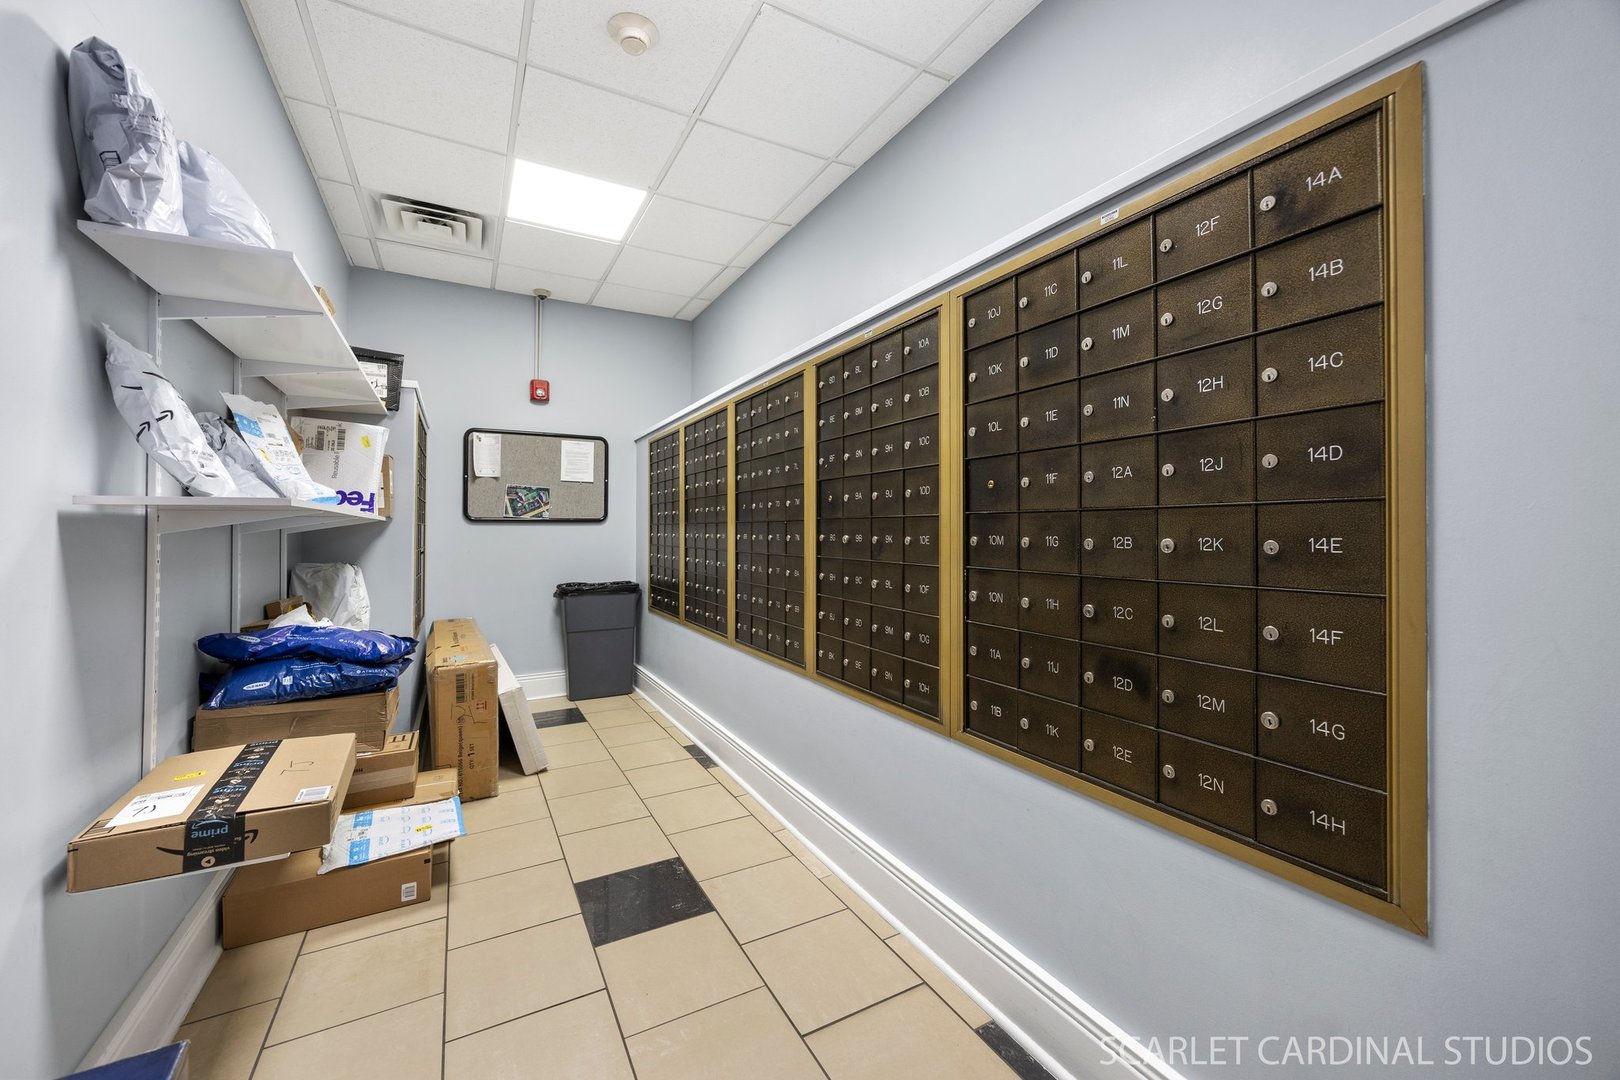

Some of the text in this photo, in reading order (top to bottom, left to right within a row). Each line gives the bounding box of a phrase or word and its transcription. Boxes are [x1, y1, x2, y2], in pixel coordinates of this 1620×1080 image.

[1306, 167, 1342, 191] 14A
[1196, 216, 1220, 236] 12F
[1113, 257, 1128, 270] 11L
[1309, 259, 1343, 281] 14B
[1044, 283, 1057, 296] 11C
[1197, 296, 1222, 314] 12G
[988, 306, 1000, 319] 10J
[1112, 324, 1129, 340] 11M
[919, 338, 929, 348] 10A
[1046, 347, 1058, 359] 11D
[1308, 352, 1343, 372] 14C
[988, 363, 1002, 375] 10K
[1198, 376, 1223, 392] 12H
[919, 387, 929, 396] 10B
[1113, 396, 1129, 408] 11N
[1046, 410, 1058, 421] 11E
[988, 422, 1002, 432] 10L
[919, 436, 929, 445] 10C
[1308, 445, 1342, 462] 14D
[1200, 457, 1222, 471] 12J
[1046, 473, 1058, 484] 11F
[1112, 466, 1132, 478] 12A
[920, 486, 930, 494] 10D
[920, 536, 930, 544] 10E
[989, 535, 1004, 545] 10M
[1046, 536, 1058, 546] 11G
[1112, 537, 1132, 548] 12B
[1198, 538, 1223, 551] 12K
[1309, 538, 1342, 553] 14E
[920, 585, 929, 593] 10F
[989, 592, 1003, 603] 10N
[1046, 598, 1059, 610] 11H
[1113, 606, 1133, 620] 12C
[1199, 616, 1223, 632] 12L
[919, 634, 929, 644] 10G
[1310, 628, 1343, 645] 14F
[990, 649, 1001, 660] 11A
[1048, 661, 1059, 673] 11J
[919, 683, 929, 693] 10H
[1113, 676, 1132, 691] 12D
[1197, 694, 1224, 712] 12M
[991, 705, 1001, 717] 11B
[1046, 724, 1059, 737] 11K
[1310, 719, 1344, 740] 14G
[1113, 746, 1132, 763] 12E
[1198, 774, 1223, 794] 12N
[1310, 811, 1345, 835] 14H
[190, 825, 229, 838] prime
[186, 848, 214, 856] streaming
